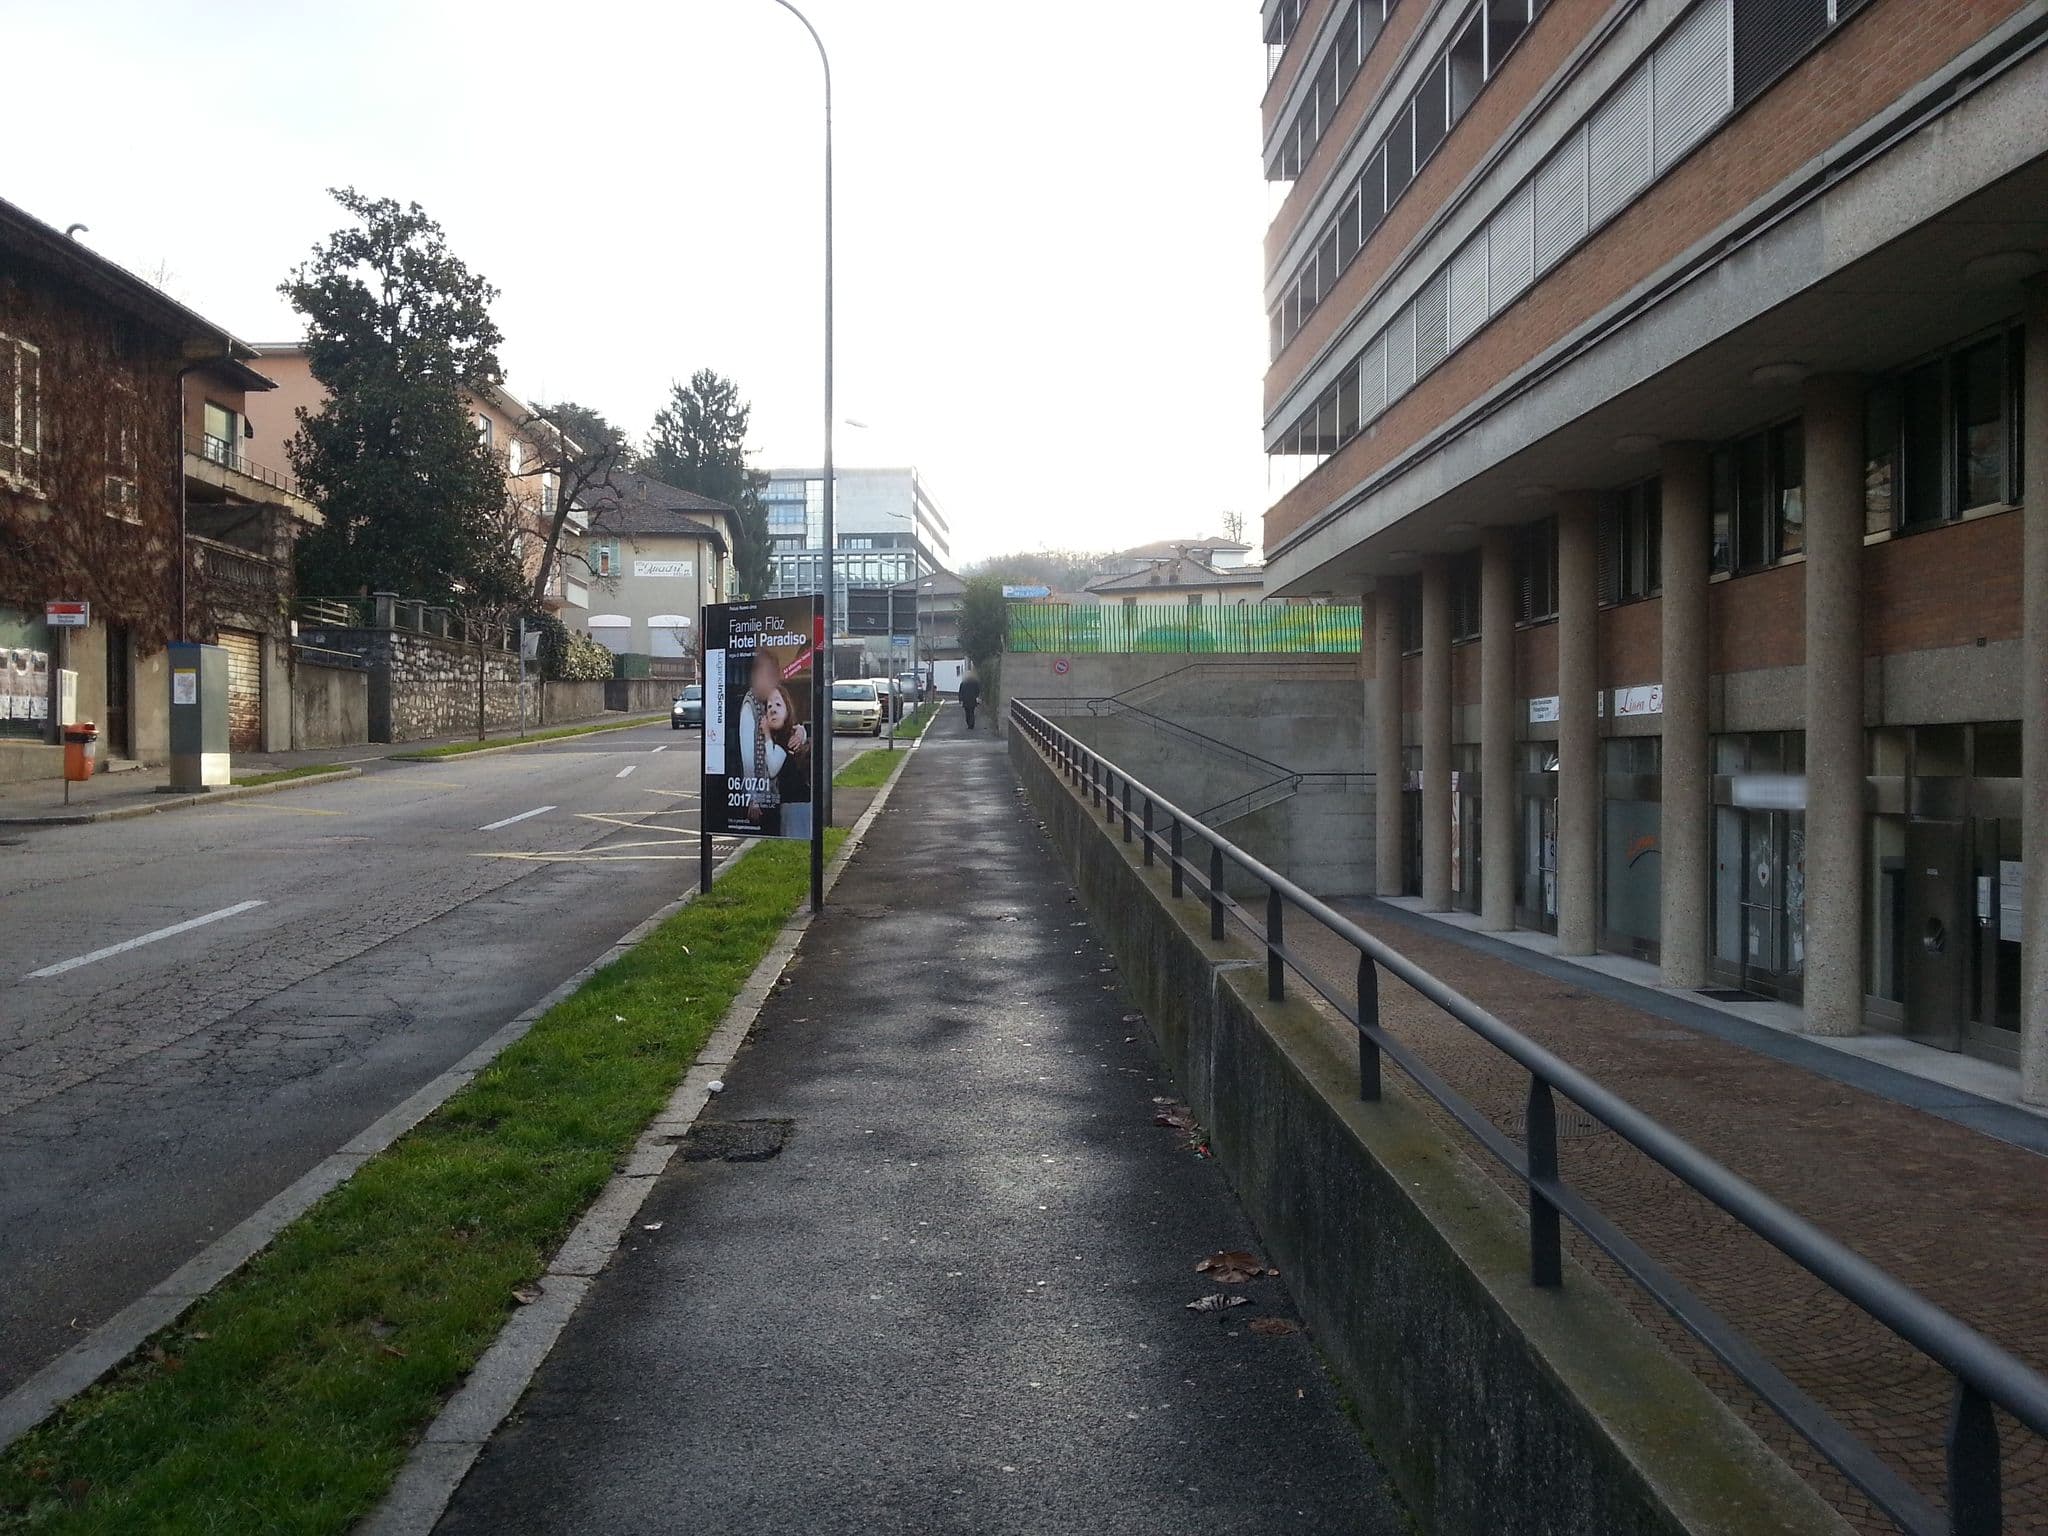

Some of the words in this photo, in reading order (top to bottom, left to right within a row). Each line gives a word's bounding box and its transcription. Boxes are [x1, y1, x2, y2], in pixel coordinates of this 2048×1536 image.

[729, 617, 762, 633] Familie
[765, 616, 785, 631] Flöz
[729, 634, 757, 649] Hotel
[760, 631, 807, 647] Paradiso
[728, 777, 770, 791] 06/07.01
[728, 793, 752, 807] 2017
